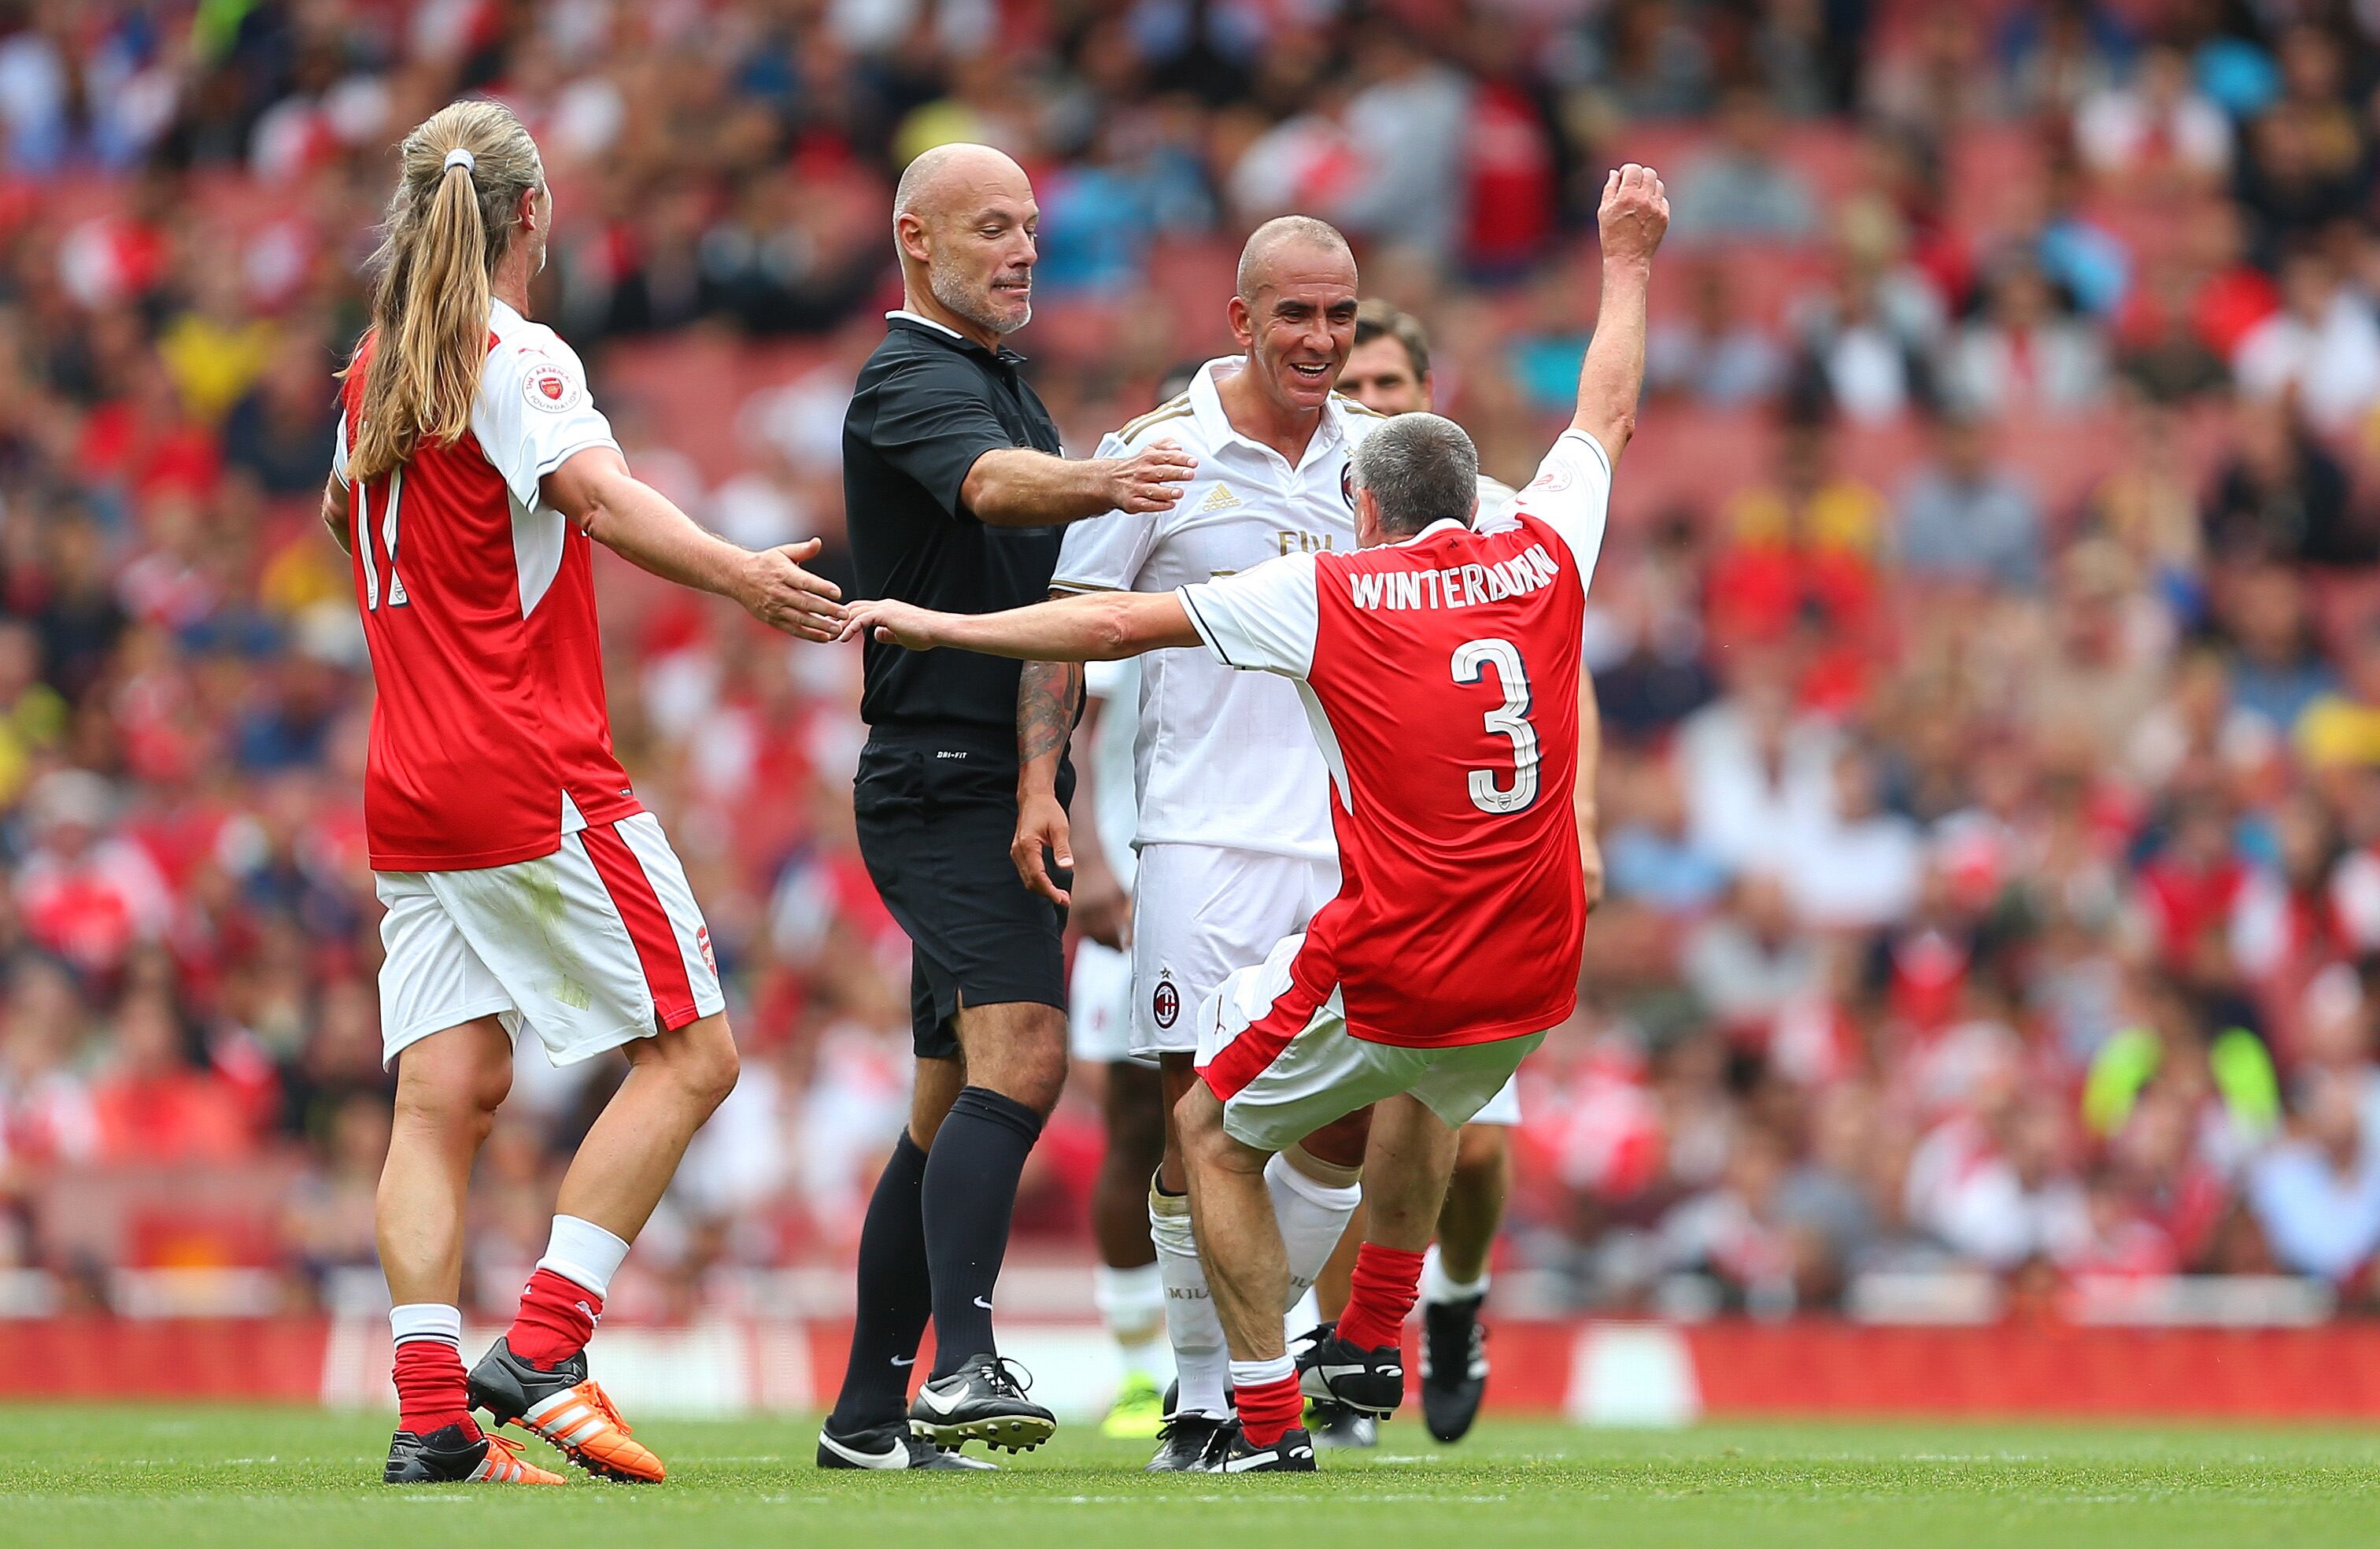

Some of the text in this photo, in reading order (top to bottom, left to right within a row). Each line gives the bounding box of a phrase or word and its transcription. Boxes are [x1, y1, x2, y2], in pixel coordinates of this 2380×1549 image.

[536, 368, 572, 383] ARSENAL
[530, 390, 577, 410] FOUNDATION
[1202, 498, 1242, 512] adidas
[1450, 638, 1543, 815] 3
[1169, 1286, 1209, 1299] MIL
